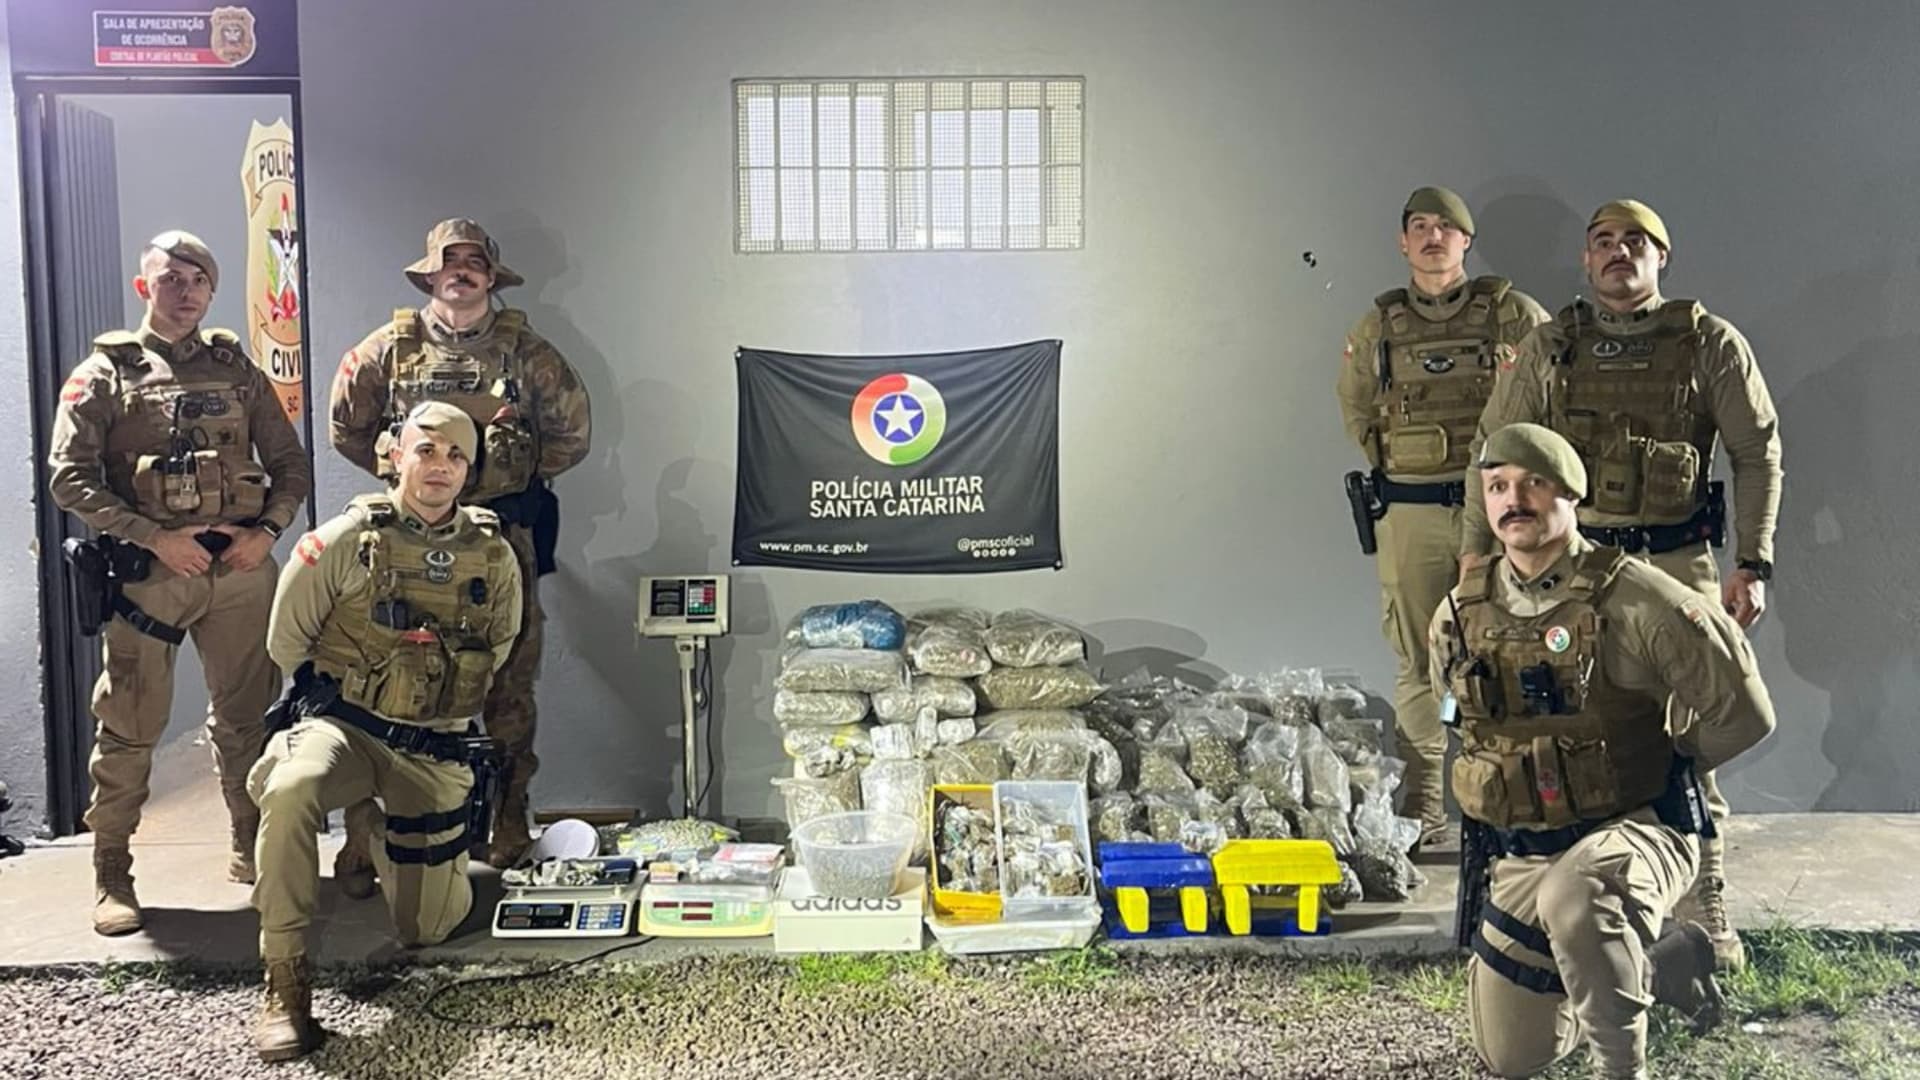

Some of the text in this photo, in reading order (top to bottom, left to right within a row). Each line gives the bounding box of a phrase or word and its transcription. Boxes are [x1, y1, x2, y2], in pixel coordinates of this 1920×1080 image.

[103, 17, 205, 31] SALA DE APRESENTAÇÃO
[121, 32, 188, 45] DE OCORRÊNCIA
[811, 475, 983, 499] POLÍCIA MILITAR
[809, 495, 985, 518] SANTA CATARINA
[759, 541, 869, 555] www.pm.sc.gov.br
[958, 534, 1034, 552] @pmscoficial
